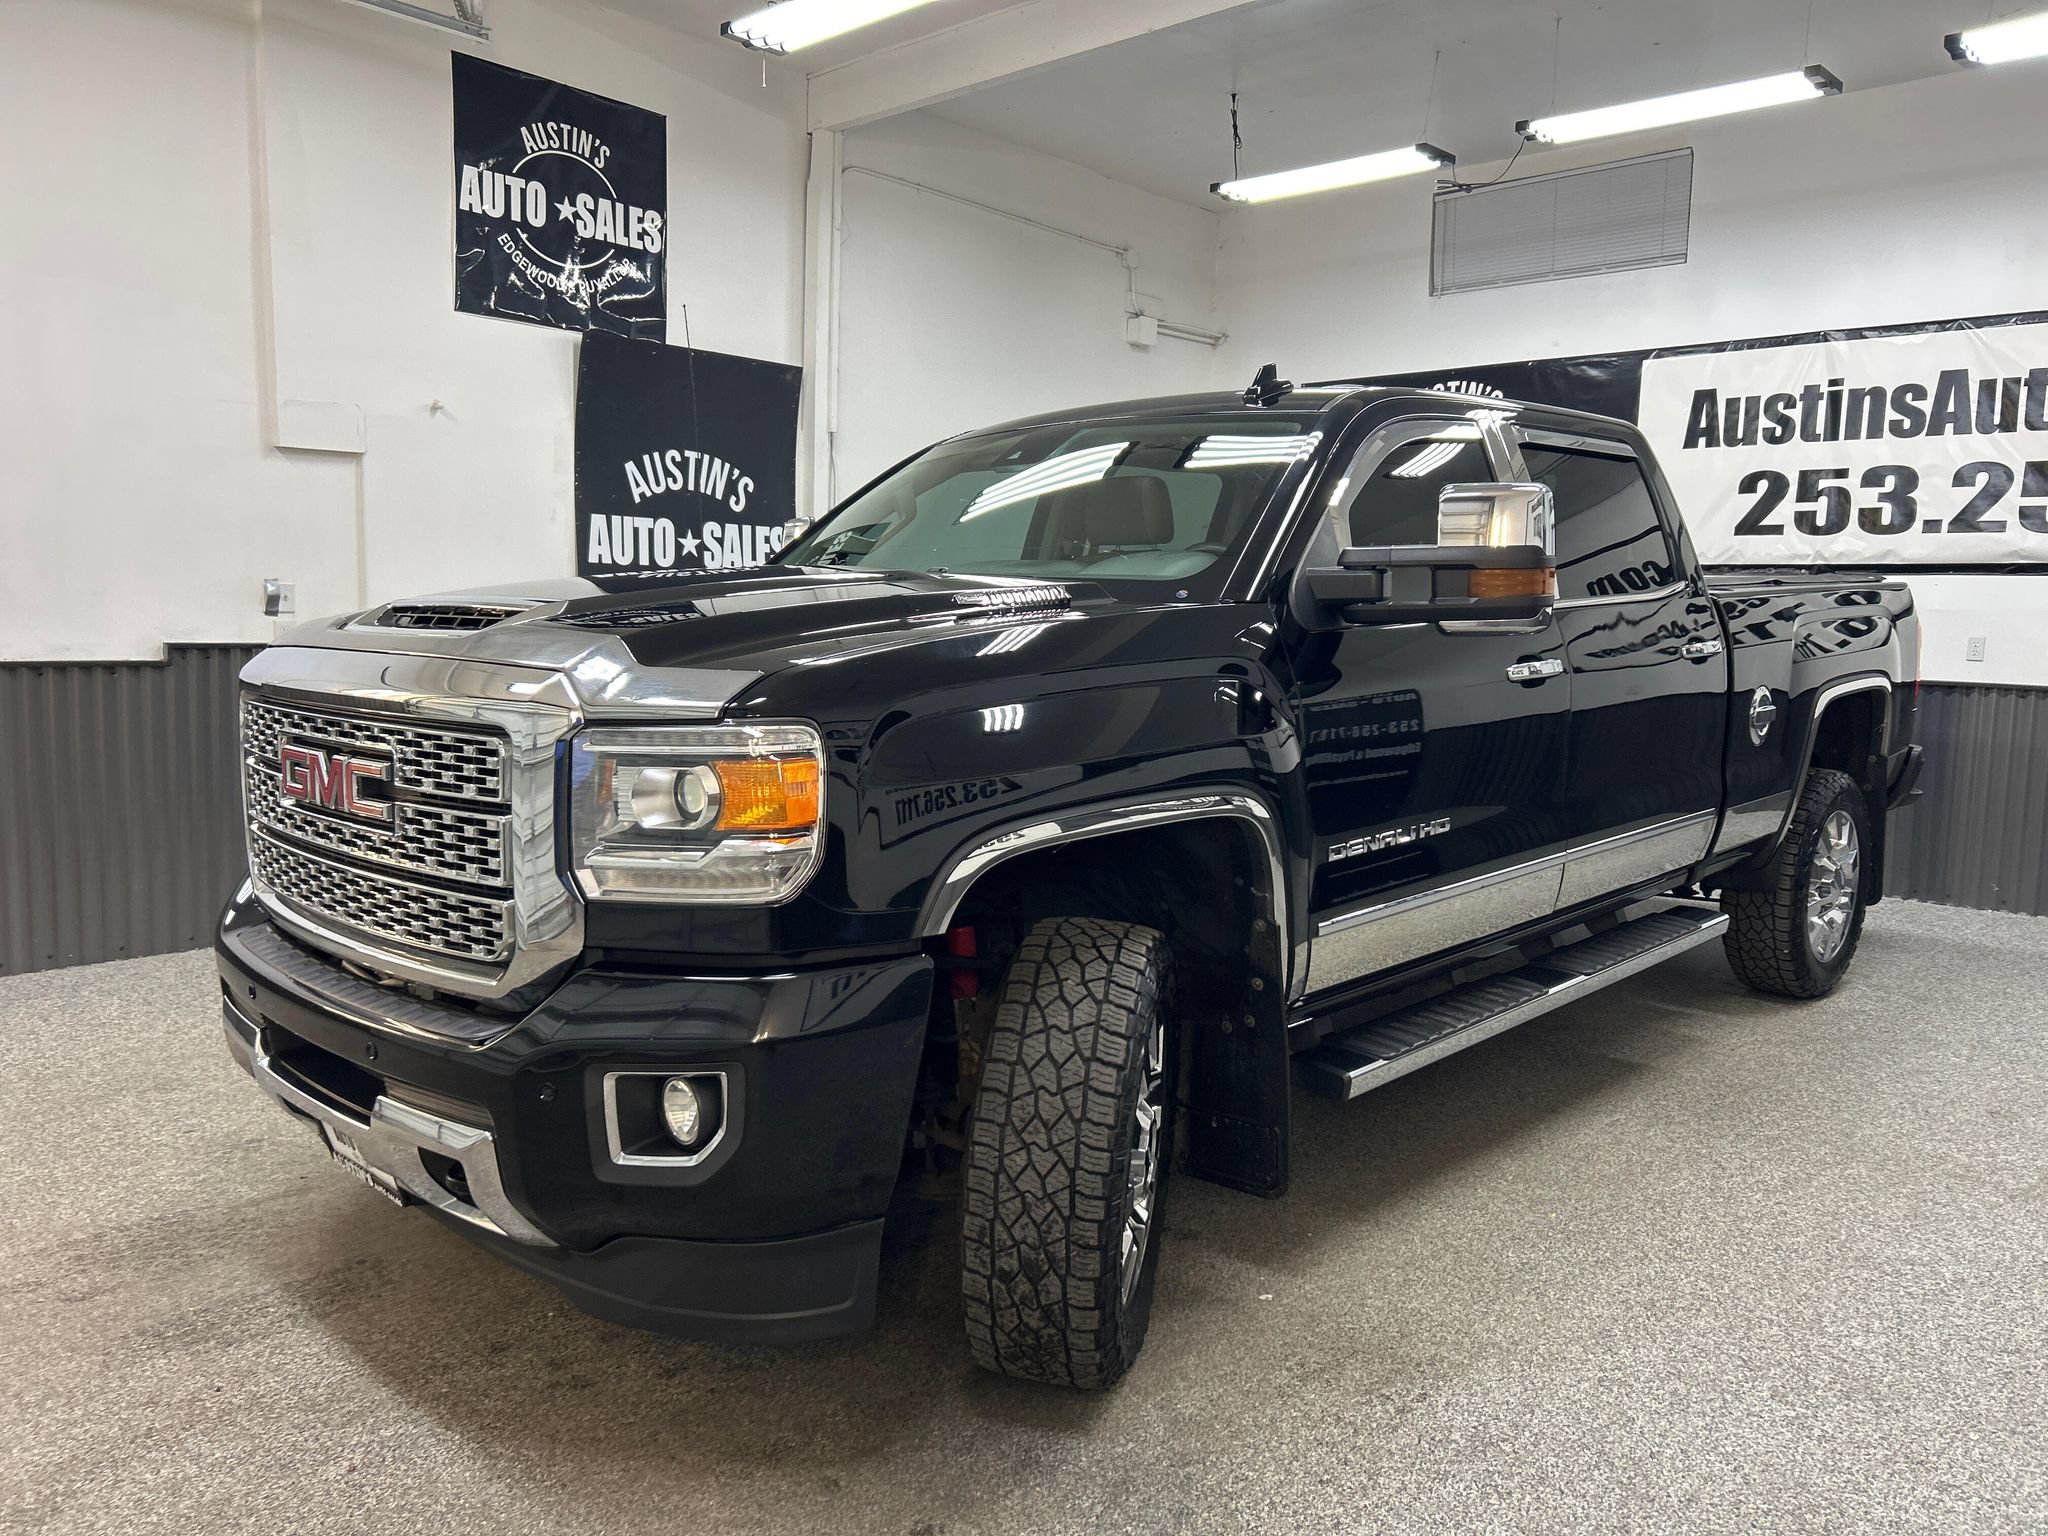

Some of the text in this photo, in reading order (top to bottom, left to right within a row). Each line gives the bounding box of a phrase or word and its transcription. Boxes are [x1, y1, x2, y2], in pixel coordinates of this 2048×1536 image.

[520, 121, 611, 169] AUSTIN'S
[459, 164, 663, 254] AUTO SALES
[624, 449, 755, 513] AUSTIN'S
[588, 513, 676, 568] AUTO
[281, 744, 393, 822] GMC
[1328, 817, 1451, 863] DENALI HD
